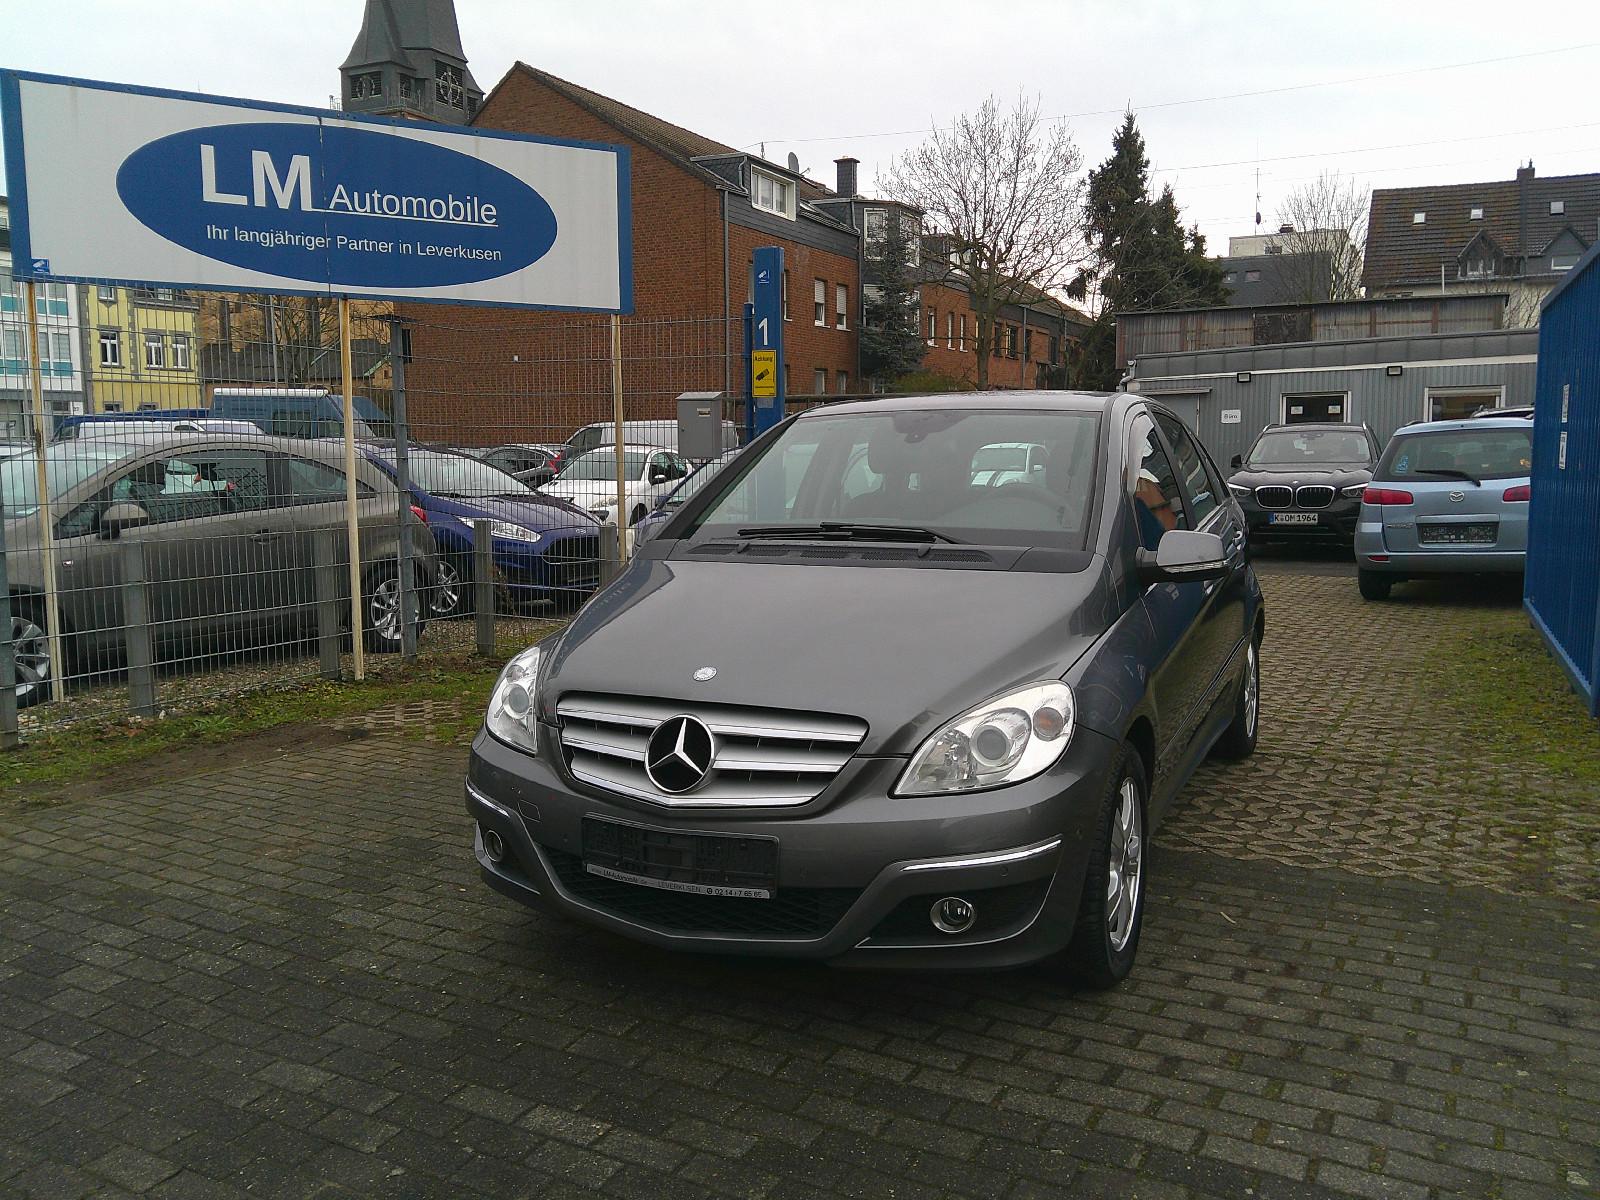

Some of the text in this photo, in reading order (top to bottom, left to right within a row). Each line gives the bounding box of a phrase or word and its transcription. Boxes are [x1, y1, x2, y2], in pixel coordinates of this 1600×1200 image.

[200, 143, 498, 225] LM Automobile
[206, 224, 503, 261] Ihr langjähriger Partner in Leverkusen
[758, 317, 768, 346] 1
